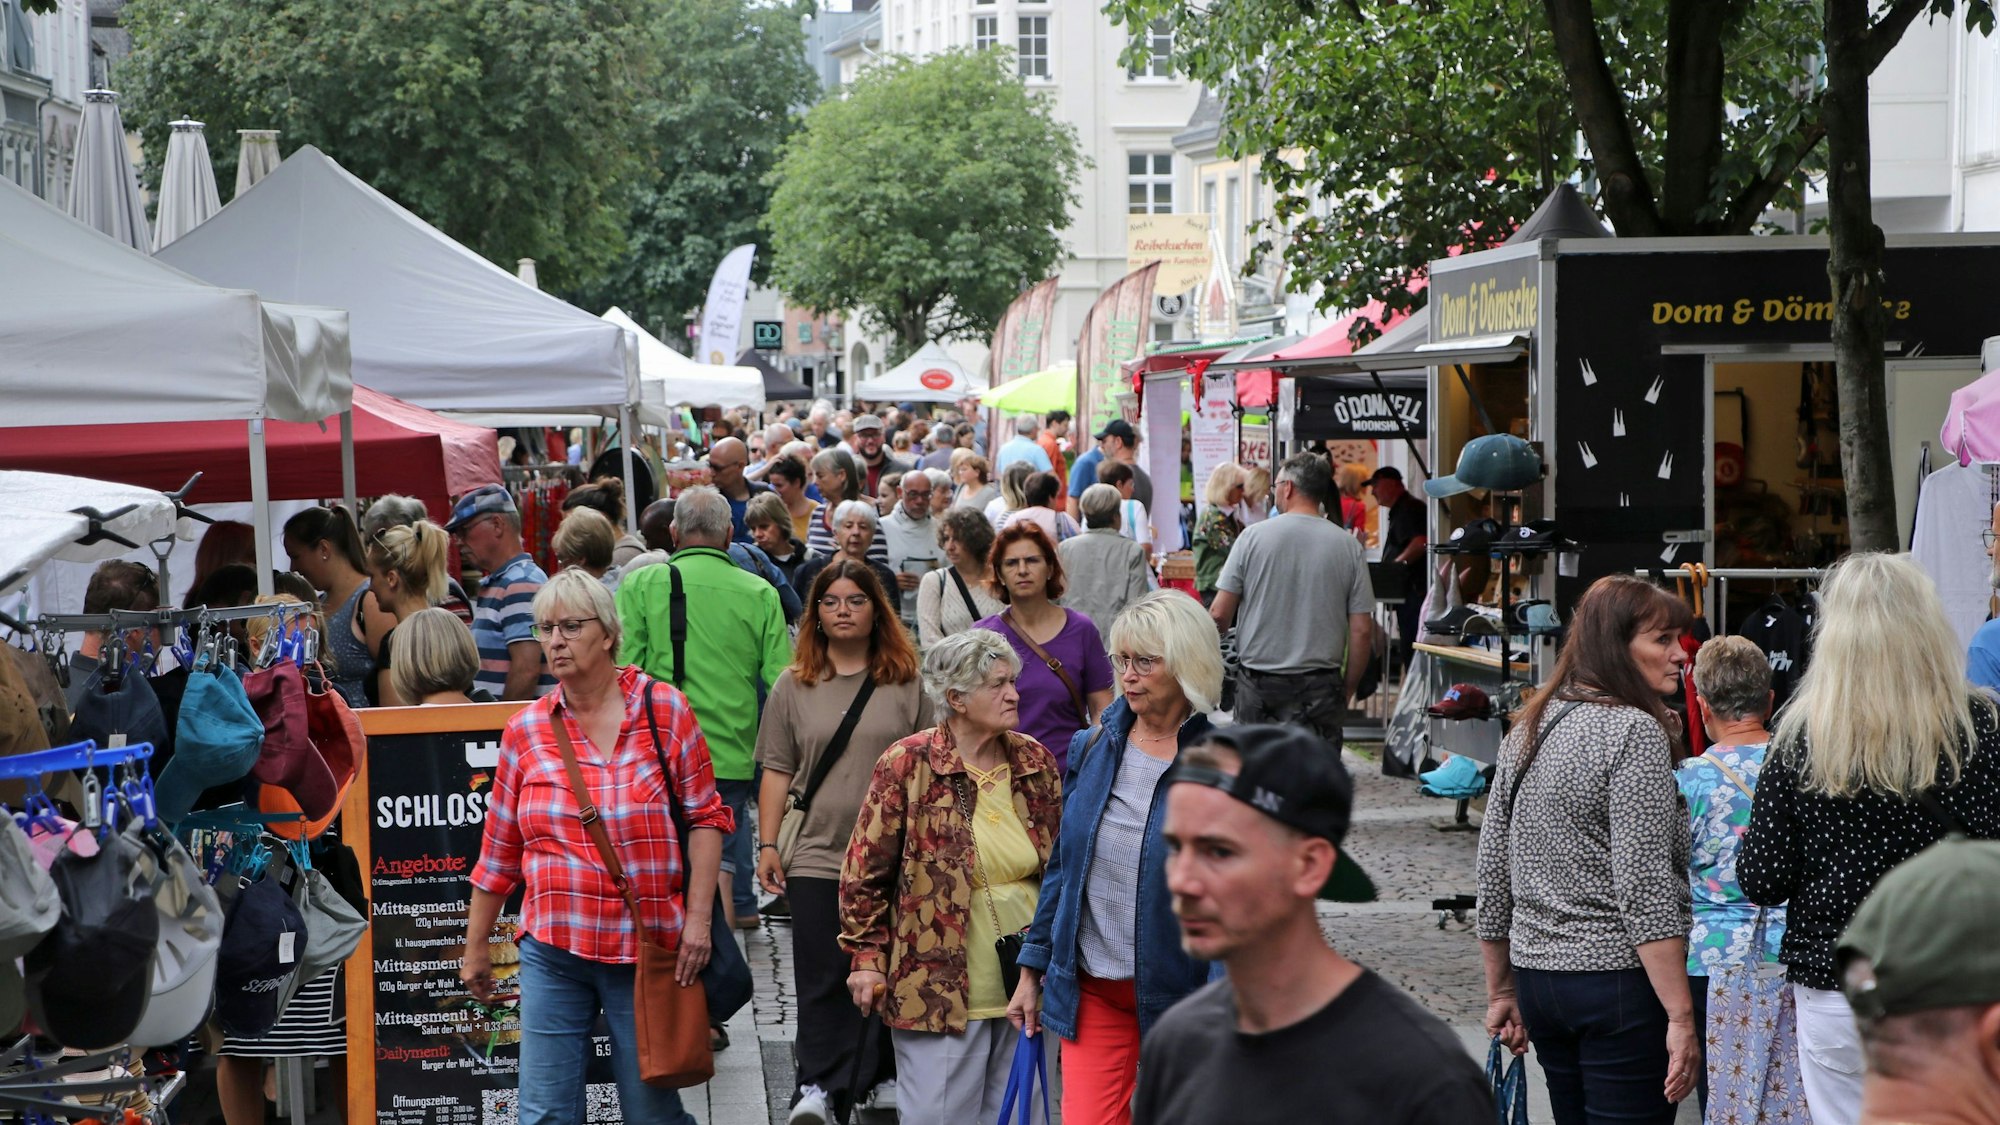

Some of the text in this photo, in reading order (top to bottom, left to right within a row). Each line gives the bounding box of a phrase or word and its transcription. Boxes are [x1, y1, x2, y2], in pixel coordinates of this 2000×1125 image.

[1134, 239, 1203, 250] Reibekuchen
[1441, 276, 1537, 338] Dom & Dömsche
[1653, 296, 1911, 325] Dom & Döme
[1352, 420, 1409, 431] MOONSHIE
[372, 854, 467, 878] Angebote:
[372, 900, 466, 917] Mittagsmenü
[415, 918, 431, 929] 120g
[432, 917, 470, 928] Hamburge
[405, 936, 455, 948] hausgemachte
[379, 981, 395, 992] 120g
[397, 980, 422, 991] Burger
[424, 980, 435, 989] der
[437, 978, 454, 988] Wahl
[375, 1008, 484, 1026] Mittagsmenü 3:
[421, 1024, 440, 1035] Salat
[441, 1024, 454, 1034] der
[455, 1022, 472, 1033] Wahl
[484, 1021, 501, 1031] 0.33
[502, 1019, 520, 1030] alkoh
[376, 1045, 451, 1063] Dailymenü:
[596, 1044, 611, 1056] 6.9
[421, 1059, 444, 1071] Burger
[446, 1059, 458, 1069] der
[459, 1057, 475, 1067] Wahl
[392, 1094, 459, 1108] Öffnungszeiten:
[468, 1113, 477, 1121] Uhr
